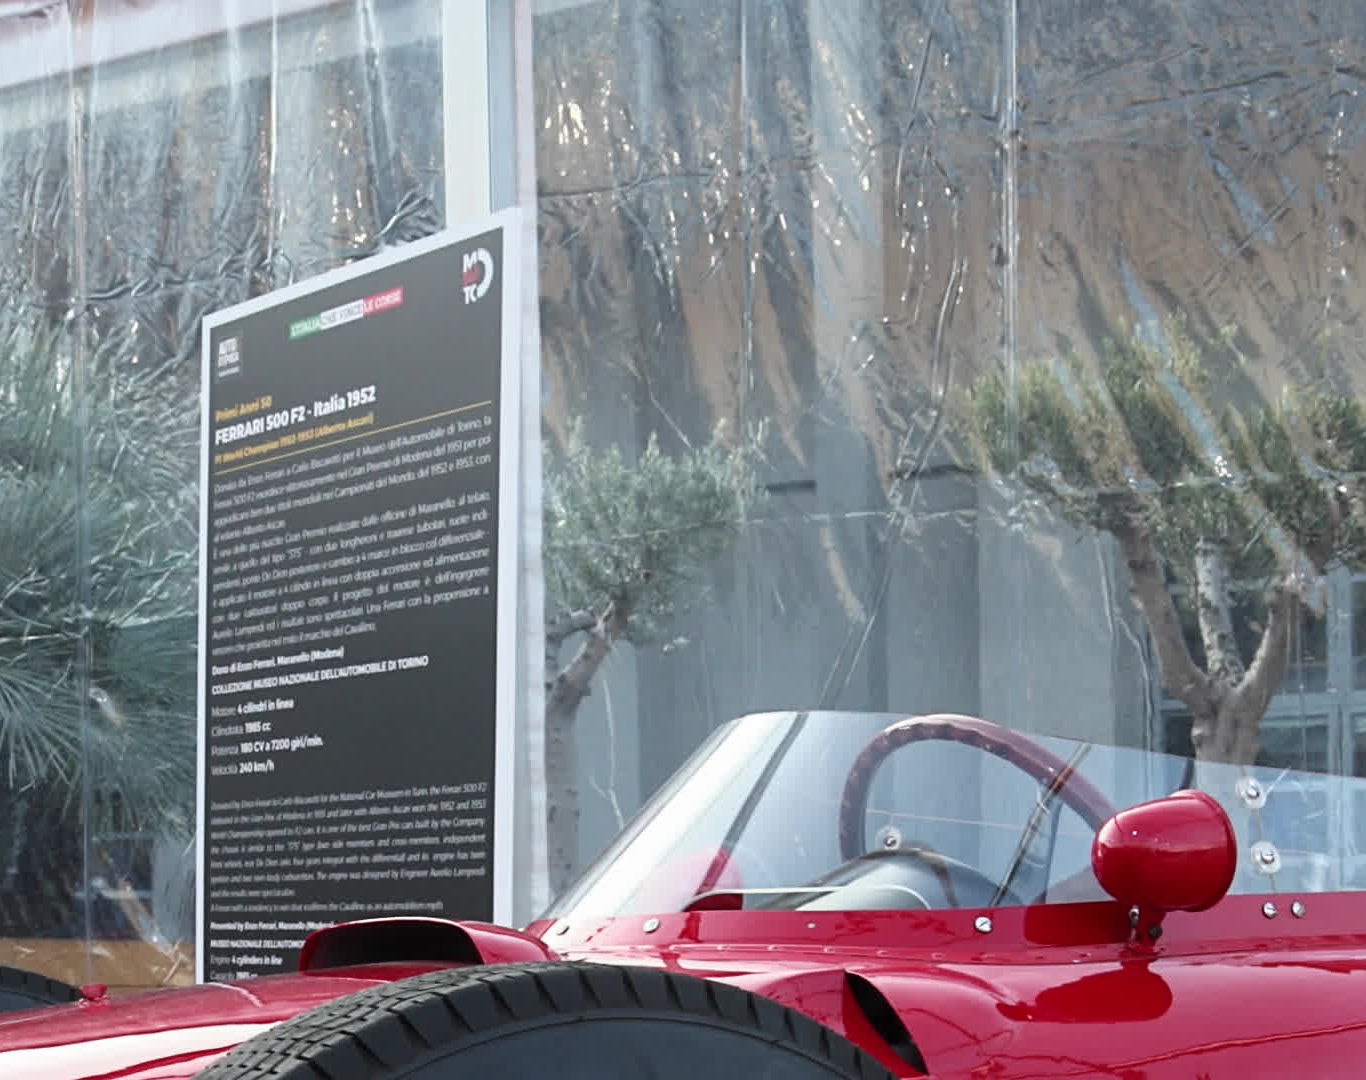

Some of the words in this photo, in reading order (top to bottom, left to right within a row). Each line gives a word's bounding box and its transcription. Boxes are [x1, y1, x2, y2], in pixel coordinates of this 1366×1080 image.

[215, 416, 263, 445] FERRARI
[266, 409, 288, 430] 500
[290, 404, 305, 423] F2
[313, 393, 345, 417] Italia
[347, 384, 375, 408] 1952
[244, 437, 279, 459] Champion
[229, 663, 235, 673] di
[277, 652, 309, 666] Maranello
[310, 647, 343, 661] (Modena)
[212, 680, 252, 694] COLLEZIONE
[253, 676, 277, 689] MUSEO
[279, 671, 319, 685] NAZIONALE
[320, 661, 387, 680] DELL'AUTOMOBILE
[388, 660, 396, 671] DI
[398, 655, 429, 669] TORINO
[237, 703, 242, 714] 4
[243, 700, 266, 713] cilindri
[268, 699, 274, 710] in
[276, 697, 293, 709] linea
[262, 722, 270, 731] cc
[240, 742, 252, 753] 180
[254, 741, 264, 752] CV
[265, 742, 269, 751] a
[271, 738, 289, 750] 7200
[239, 761, 252, 773] 240
[253, 759, 274, 772] km/h
[263, 940, 305, 948] DELL'AUTOMO
[232, 955, 235, 963] 4
[237, 955, 262, 966] cylinders
[264, 956, 269, 964] in
[271, 956, 282, 964] line
